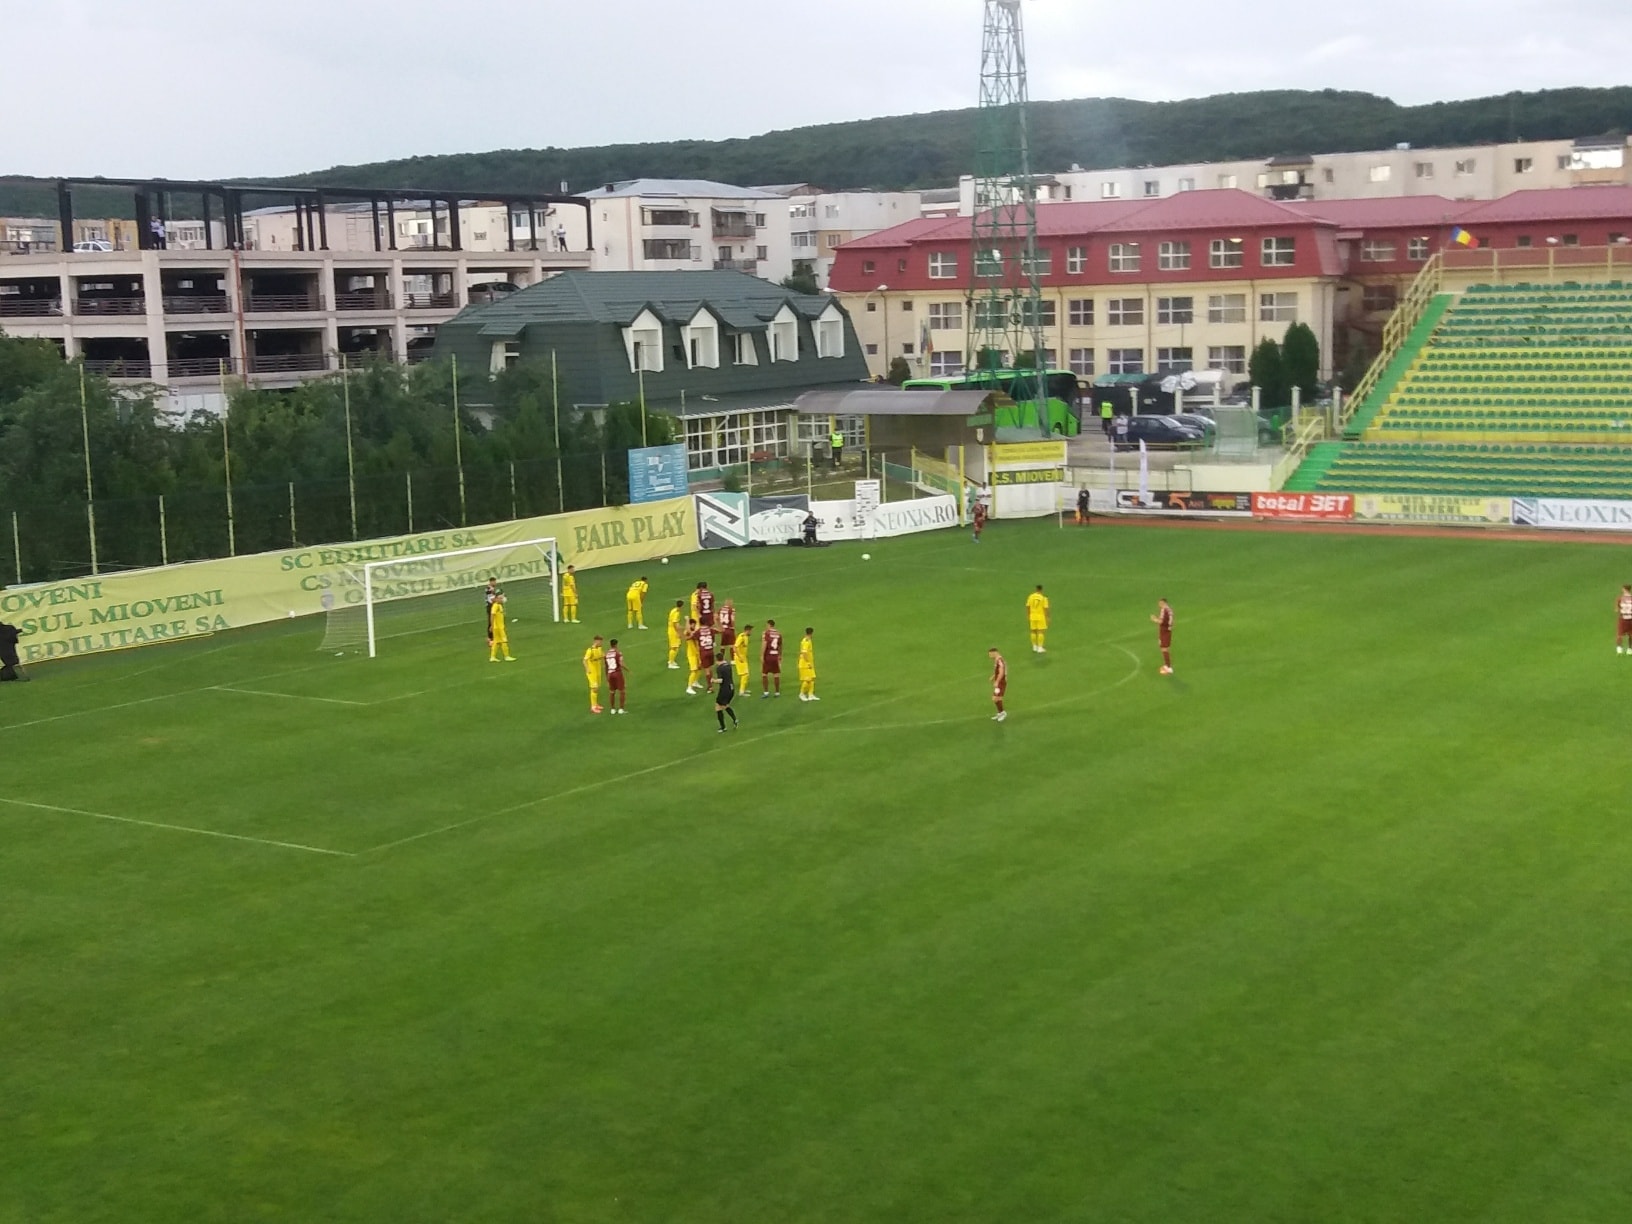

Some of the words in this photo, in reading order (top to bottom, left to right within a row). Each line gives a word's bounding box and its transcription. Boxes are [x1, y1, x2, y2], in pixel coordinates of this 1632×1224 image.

[1257, 495, 1305, 511] total
[574, 518, 629, 553] FAIR
[631, 511, 686, 544] PLAY
[280, 553, 313, 571] SC
[319, 535, 447, 567] EDILITARE
[451, 531, 480, 548] SA
[300, 574, 332, 591] CS
[445, 559, 542, 586] MIOVENI
[89, 589, 225, 625] MIOVENI
[23, 620, 189, 661] EDILITARE
[194, 614, 231, 632] SA
[770, 639, 778, 650] 4
